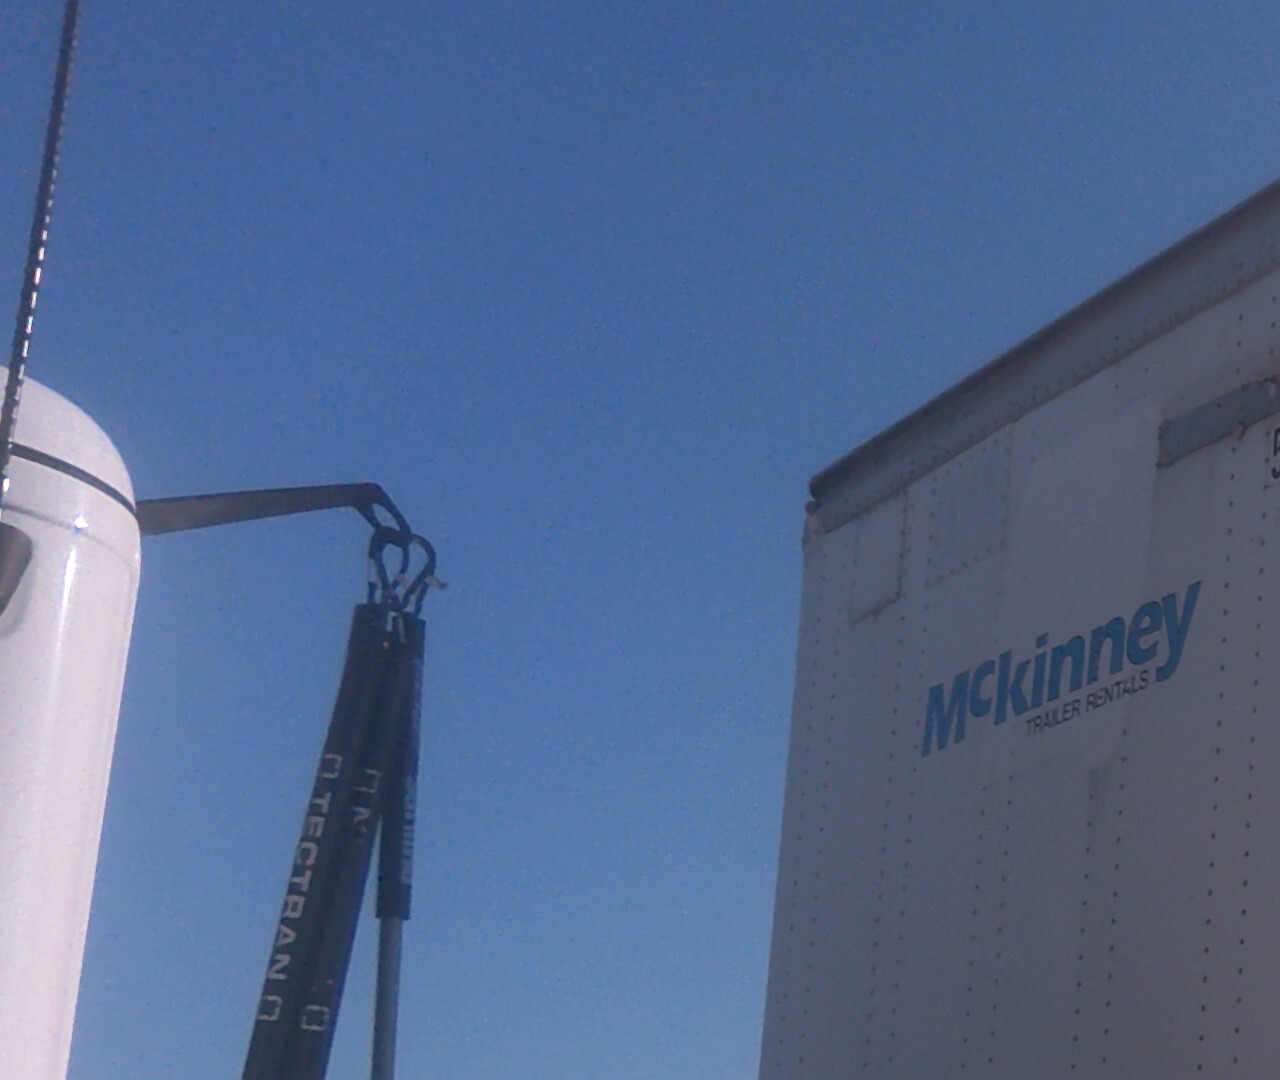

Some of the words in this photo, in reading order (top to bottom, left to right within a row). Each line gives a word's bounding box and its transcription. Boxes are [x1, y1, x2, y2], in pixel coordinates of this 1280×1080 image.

[1026, 699, 1081, 736] TRAILER
[1086, 669, 1149, 712] RENTALS
[266, 791, 332, 981] TECTRAN
